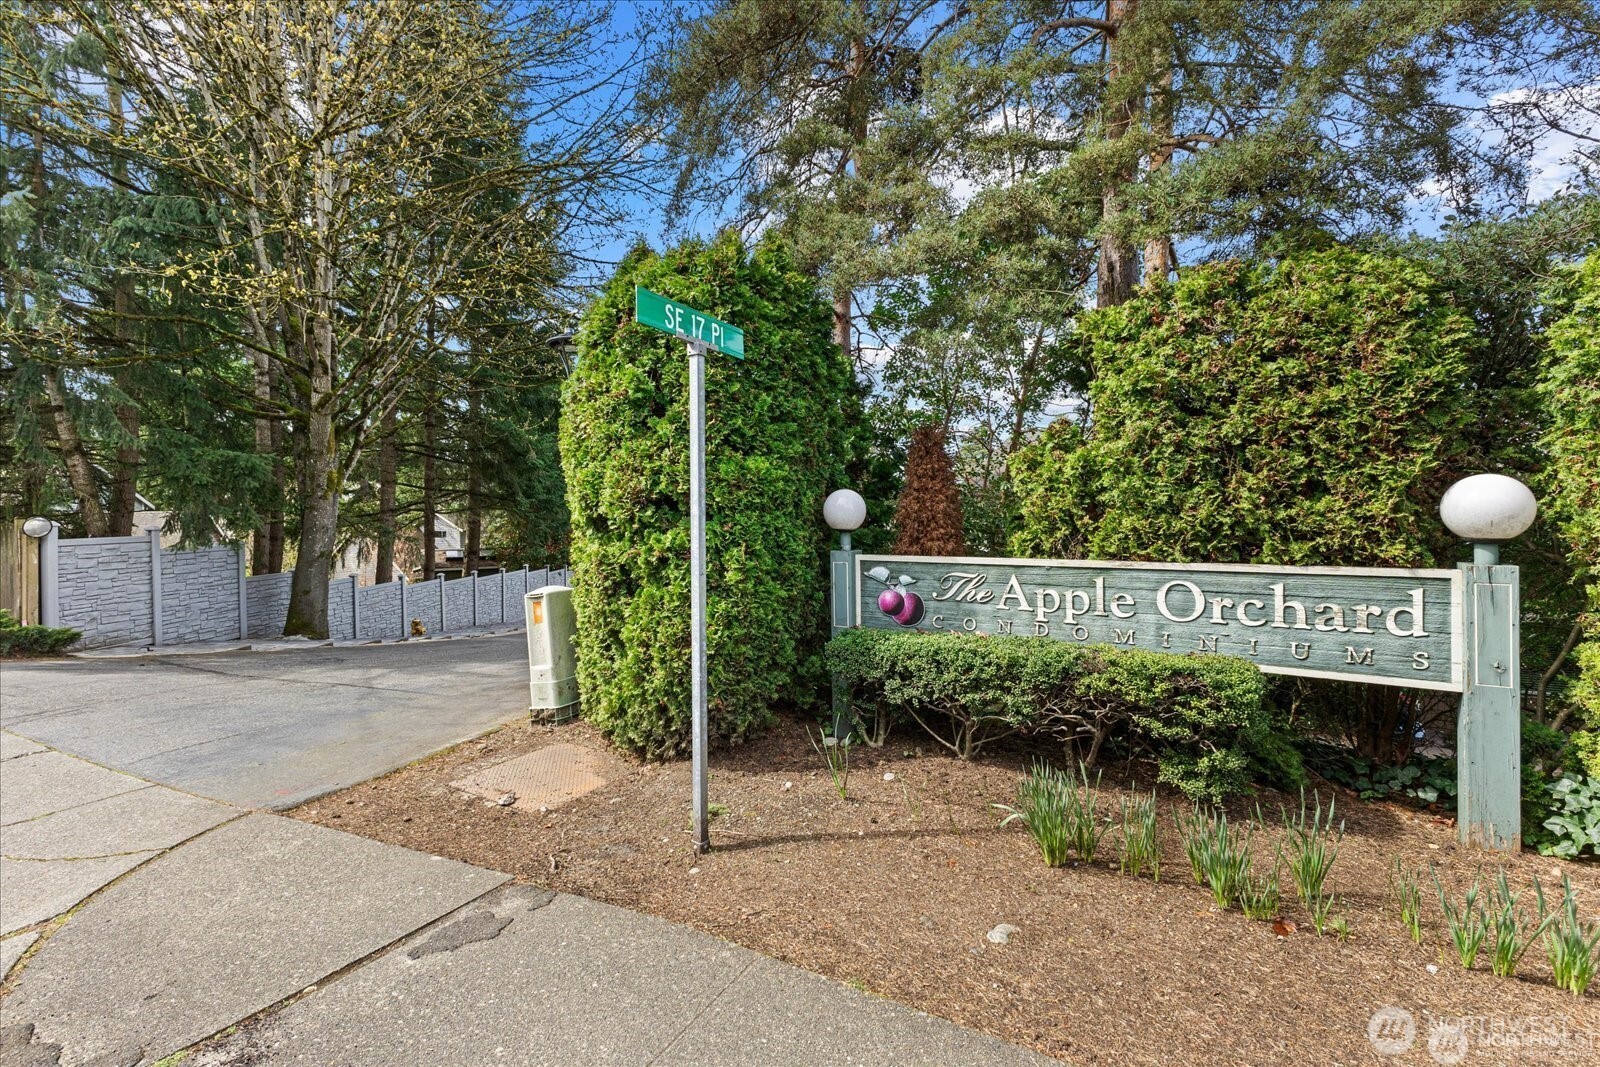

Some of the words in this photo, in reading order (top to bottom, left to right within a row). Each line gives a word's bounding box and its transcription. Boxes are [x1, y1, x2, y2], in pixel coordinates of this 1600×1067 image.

[665, 303, 685, 334] SE
[691, 314, 706, 340] 17
[711, 322, 725, 349] Pl
[931, 571, 995, 604] The
[995, 573, 1136, 625] Apple
[1156, 579, 1430, 639] Orchard
[931, 614, 1431, 671] CONDOMINIUMS
